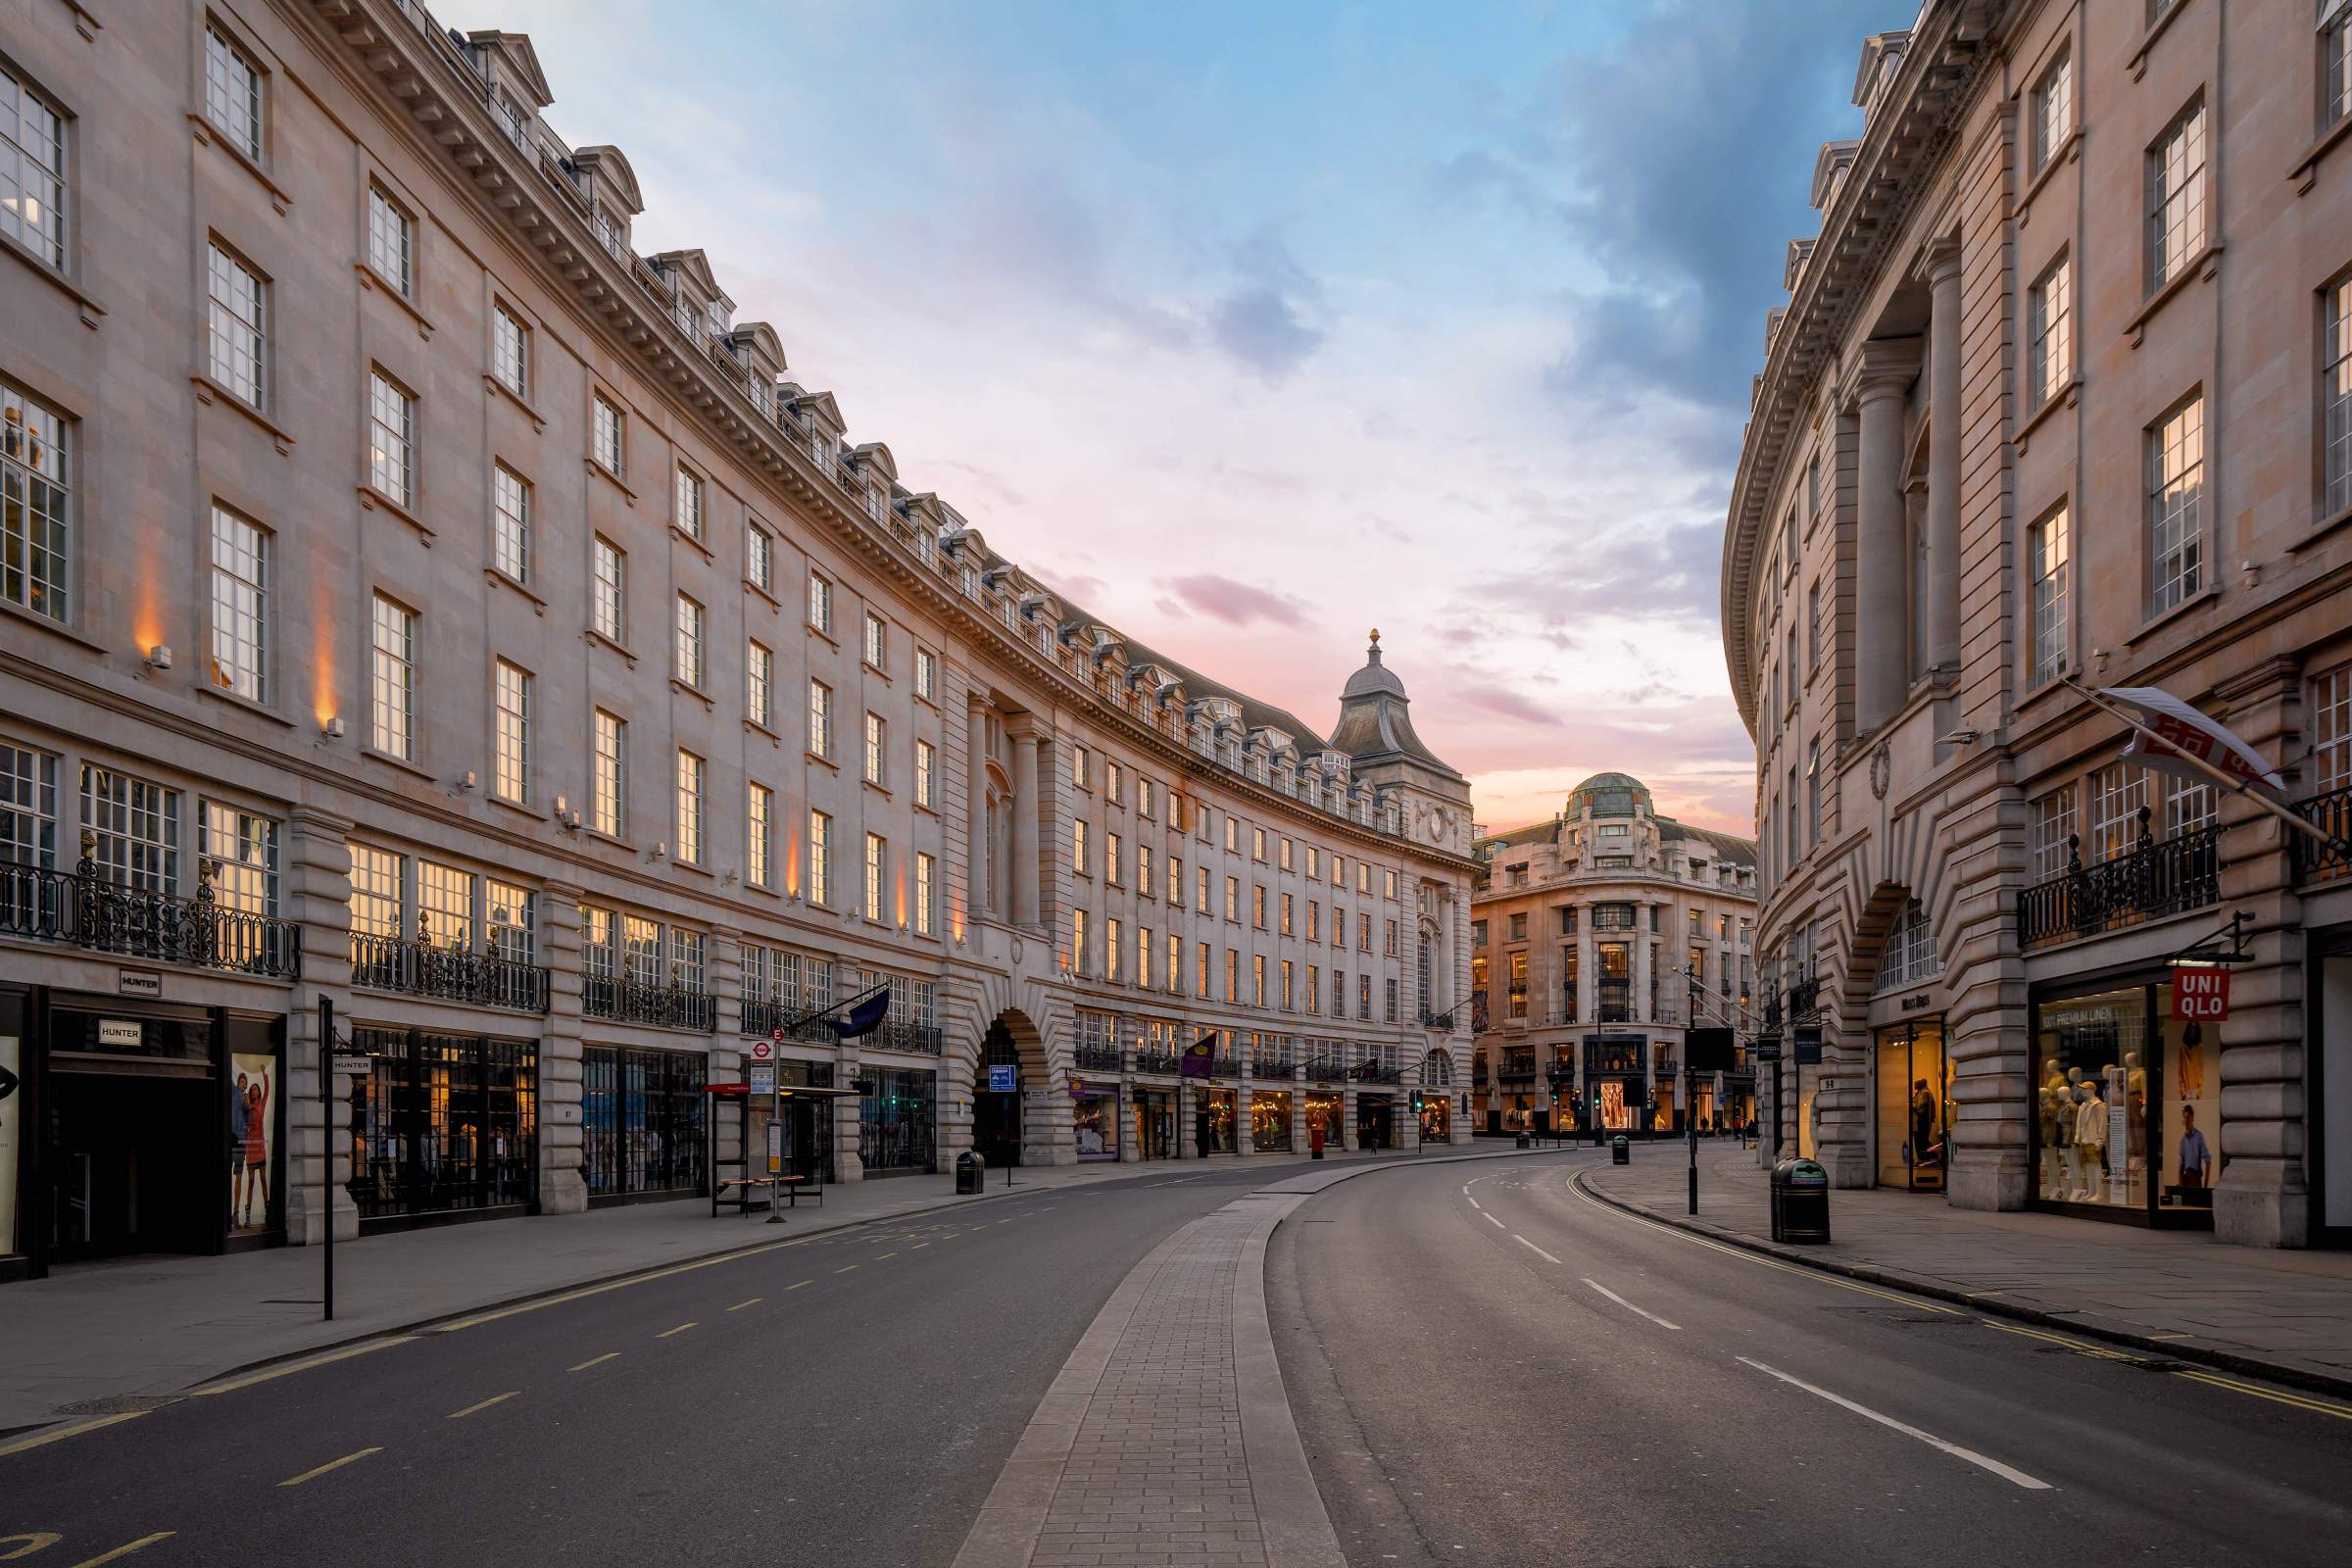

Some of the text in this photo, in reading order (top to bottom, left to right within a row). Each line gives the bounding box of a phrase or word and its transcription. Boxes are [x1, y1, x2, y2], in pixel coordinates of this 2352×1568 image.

[122, 976, 158, 989] HUNTER
[2181, 975, 2220, 994] UNI
[2180, 997, 2223, 1017] QLO
[2056, 1009, 2088, 1026] PREMIUM
[2089, 1006, 2112, 1021] LINEN
[102, 1027, 139, 1039] HUNTER
[774, 1030, 781, 1040] E
[334, 1061, 369, 1070] HUNTER
